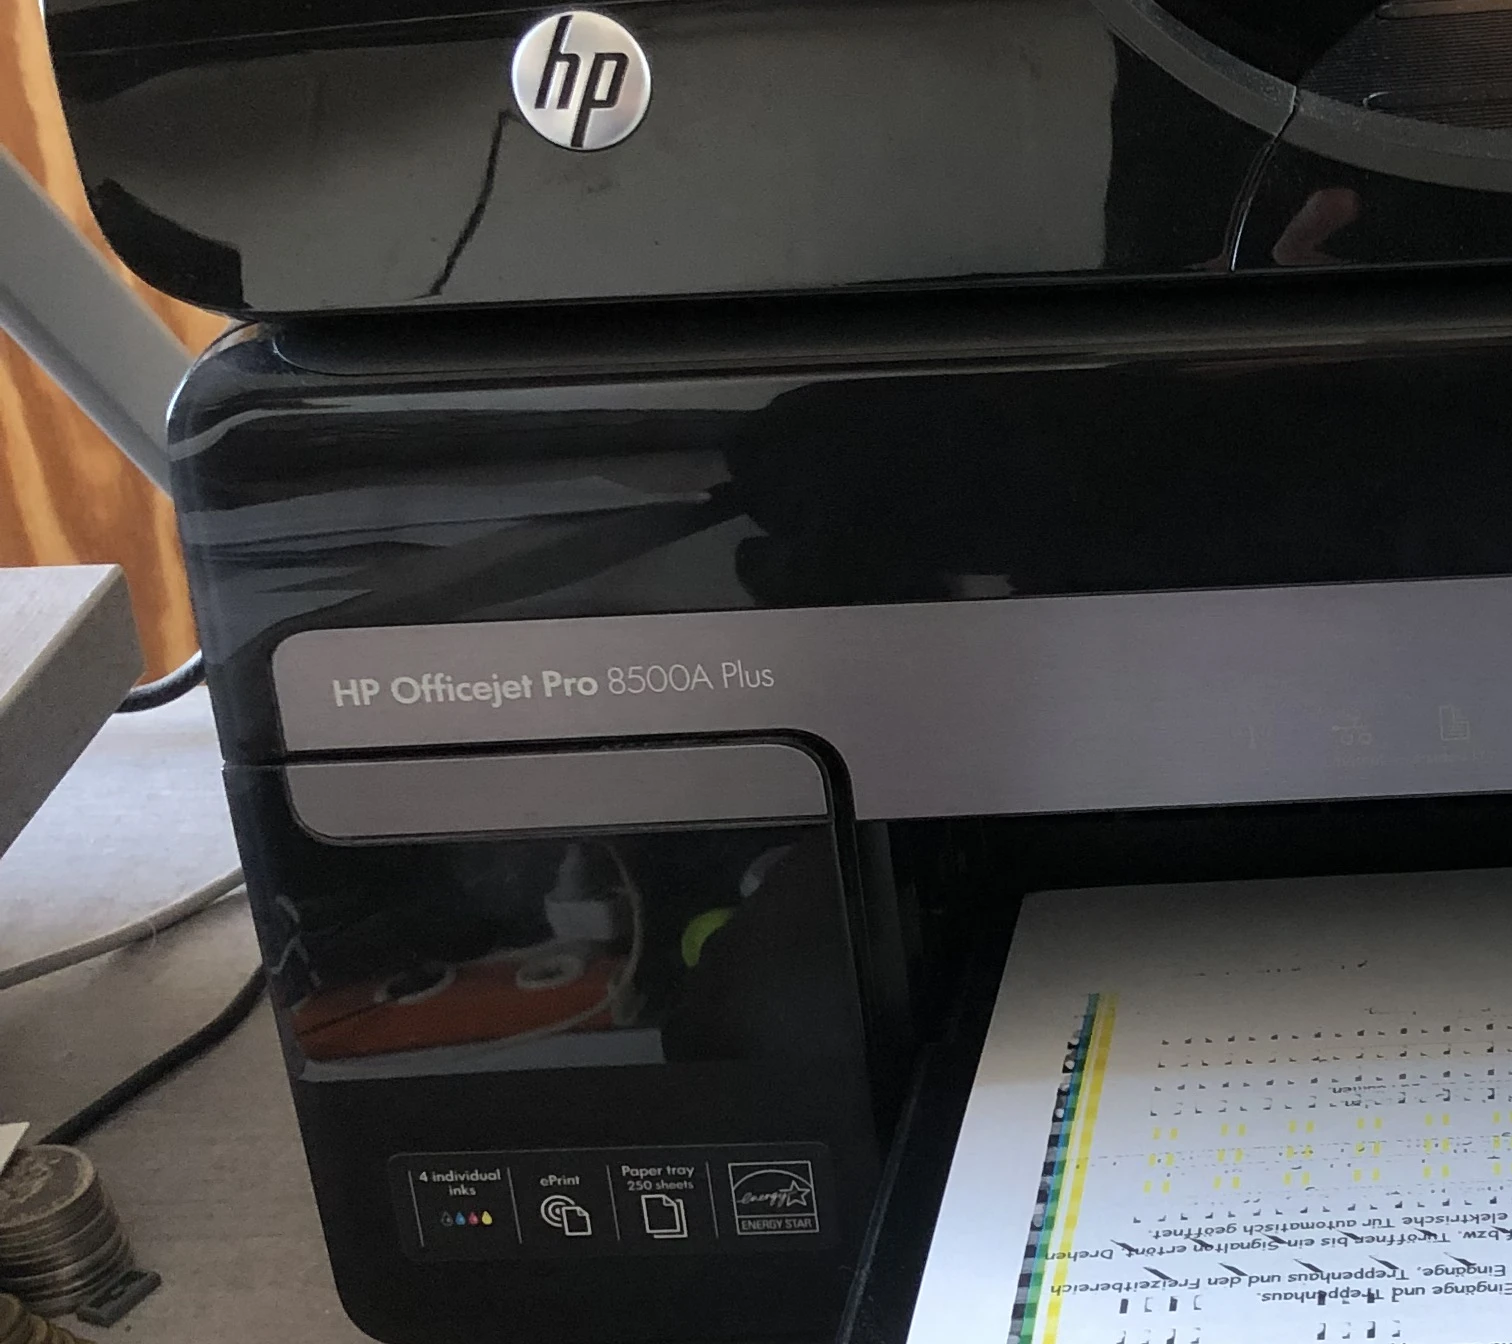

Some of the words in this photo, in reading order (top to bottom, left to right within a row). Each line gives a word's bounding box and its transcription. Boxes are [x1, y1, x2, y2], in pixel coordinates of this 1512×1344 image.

[534, 14, 630, 148] hp
[332, 678, 380, 707] HP
[390, 673, 532, 708] Officejet
[542, 670, 598, 698] Pro
[606, 664, 713, 694] 8500A
[721, 660, 774, 689] Plus
[431, 1168, 502, 1183] individual
[620, 1164, 662, 1180] Paper
[666, 1164, 695, 1178] tray
[539, 1174, 580, 1188] ePrint
[627, 1178, 654, 1192] 250
[655, 1177, 695, 1191] sheets
[448, 1184, 477, 1198] inks
[1243, 1219, 1357, 1236] automatisch
[1362, 1218, 1393, 1231] Tür
[1401, 1212, 1508, 1228] elektrische
[1148, 1224, 1237, 1240] geöffnet.
[1355, 1231, 1451, 1247] Türöffner
[1457, 1229, 1500, 1242] bzw.
[1192, 1239, 1279, 1254] Signalton
[1287, 1237, 1315, 1250] ein
[1320, 1236, 1347, 1249] bis
[1045, 1248, 1114, 1264] Drehen
[1121, 1244, 1187, 1260] ertönt.
[1288, 1268, 1409, 1285] Treppenhaus
[1417, 1262, 1506, 1278] Eingänge,
[1051, 1278, 1201, 1296] Freizeitbereich
[1207, 1275, 1242, 1288] den
[1248, 1274, 1281, 1287] und
[1256, 1286, 1384, 1305] Treppenhaus.
[1391, 1286, 1426, 1301] und
